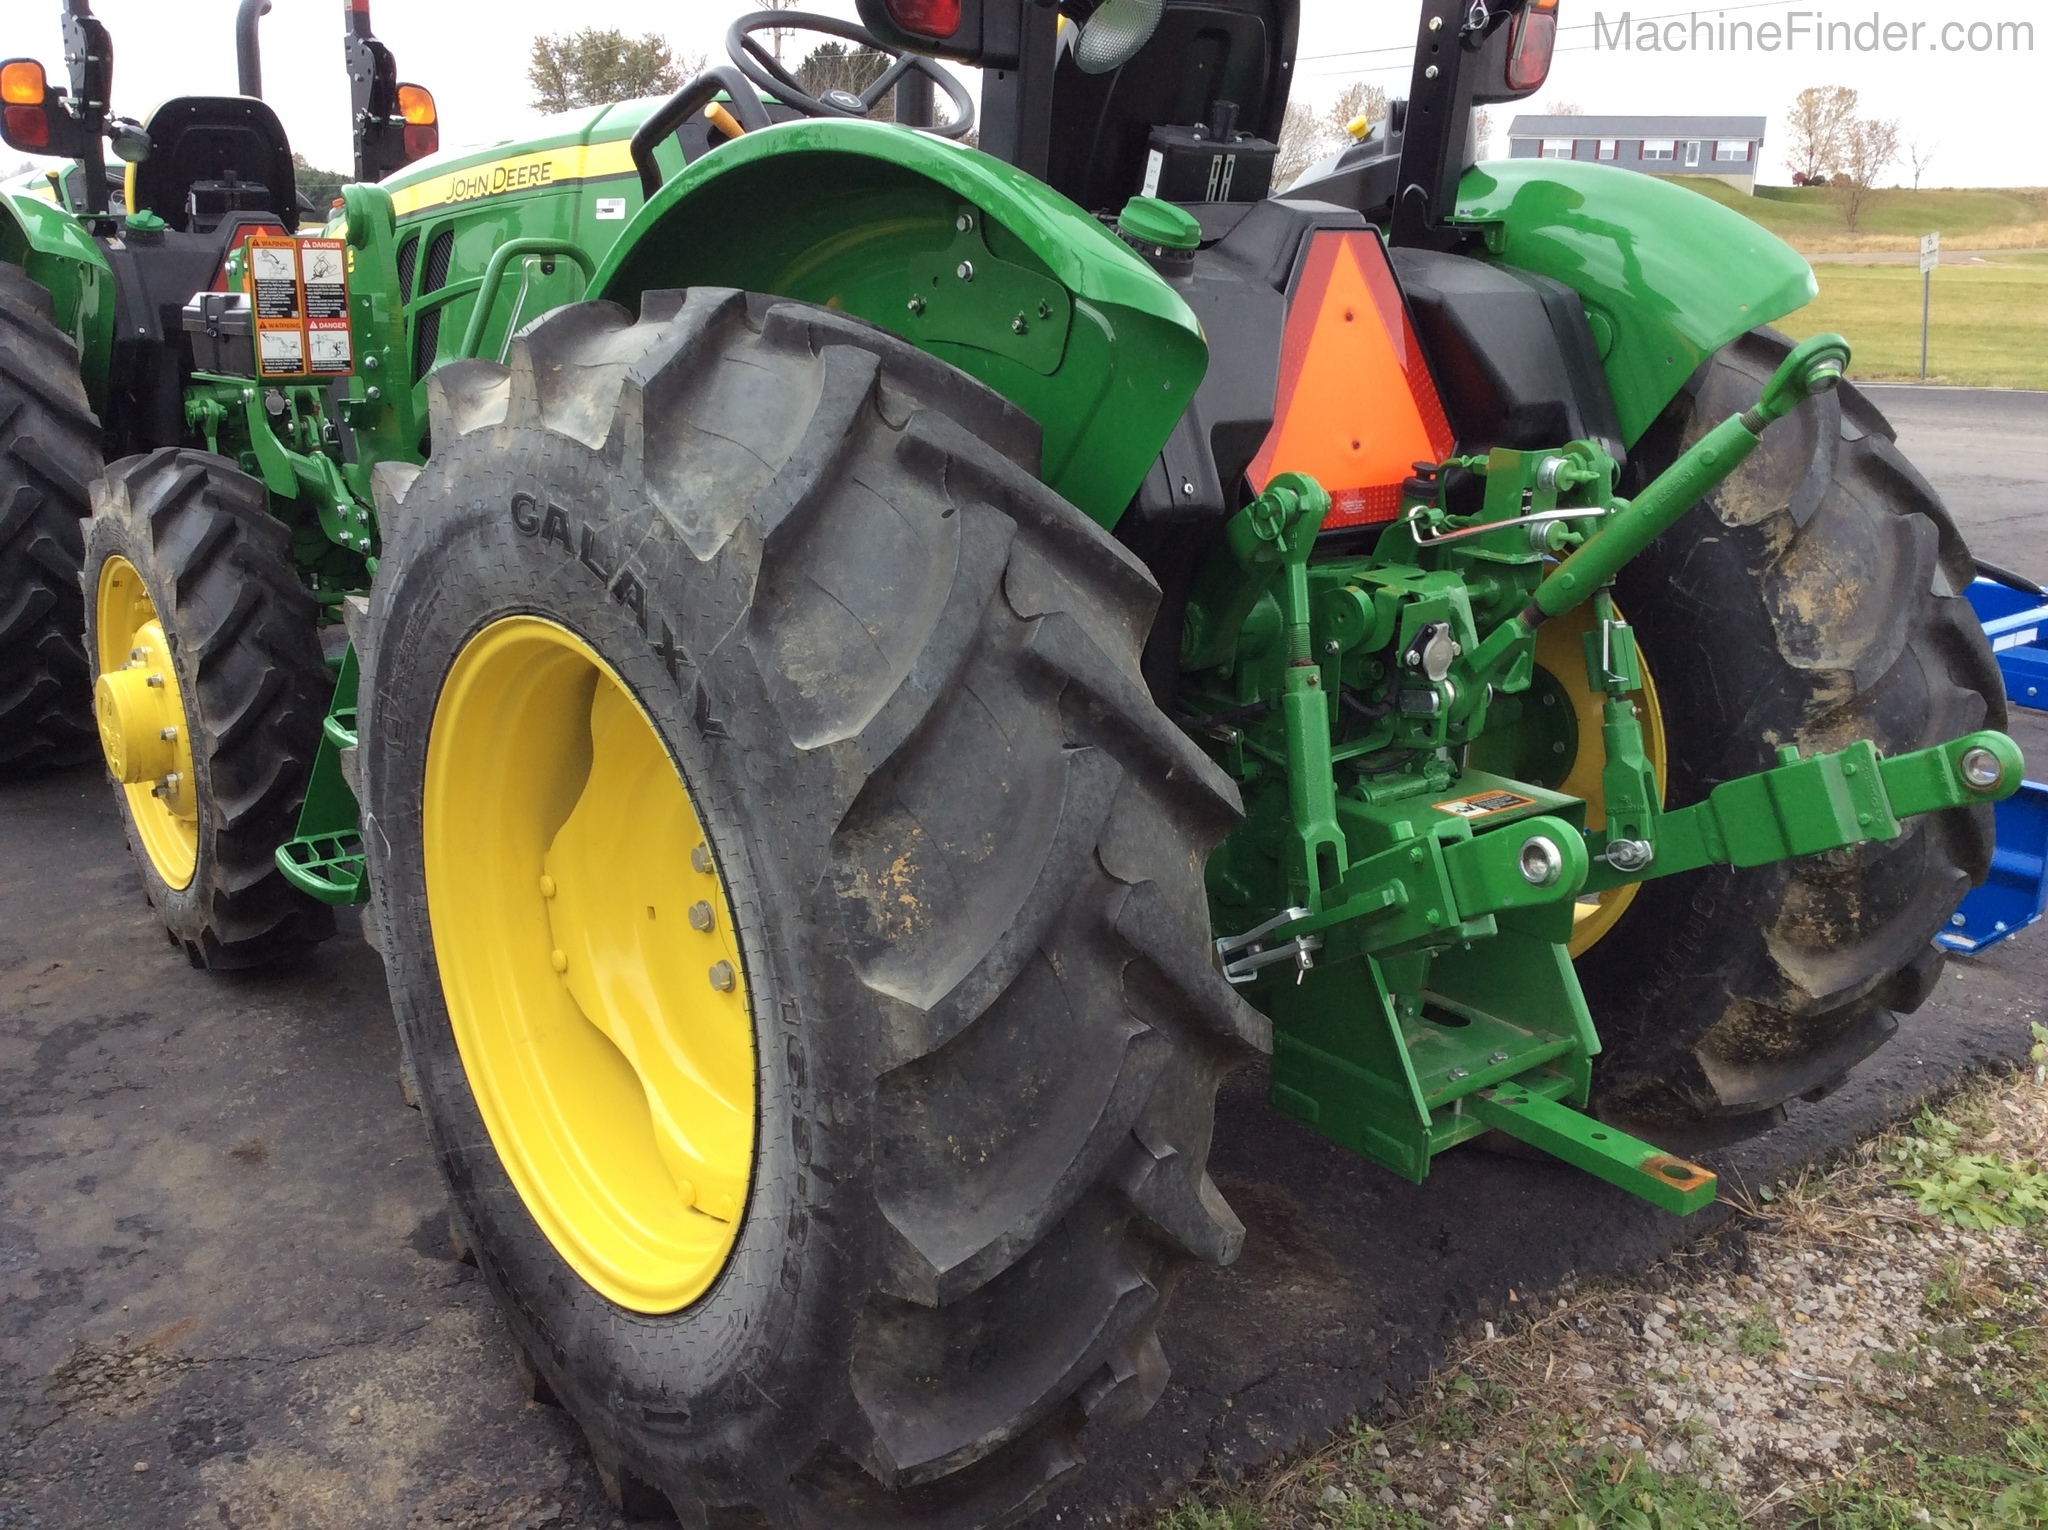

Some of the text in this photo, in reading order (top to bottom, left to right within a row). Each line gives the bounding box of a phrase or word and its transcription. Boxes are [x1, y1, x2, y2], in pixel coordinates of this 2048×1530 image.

[446, 161, 552, 201] JOHN DEERE
[312, 241, 341, 249] DANGER
[268, 322, 301, 330] WARNING
[319, 321, 347, 329] DANGER
[510, 490, 730, 740] GALAXY
